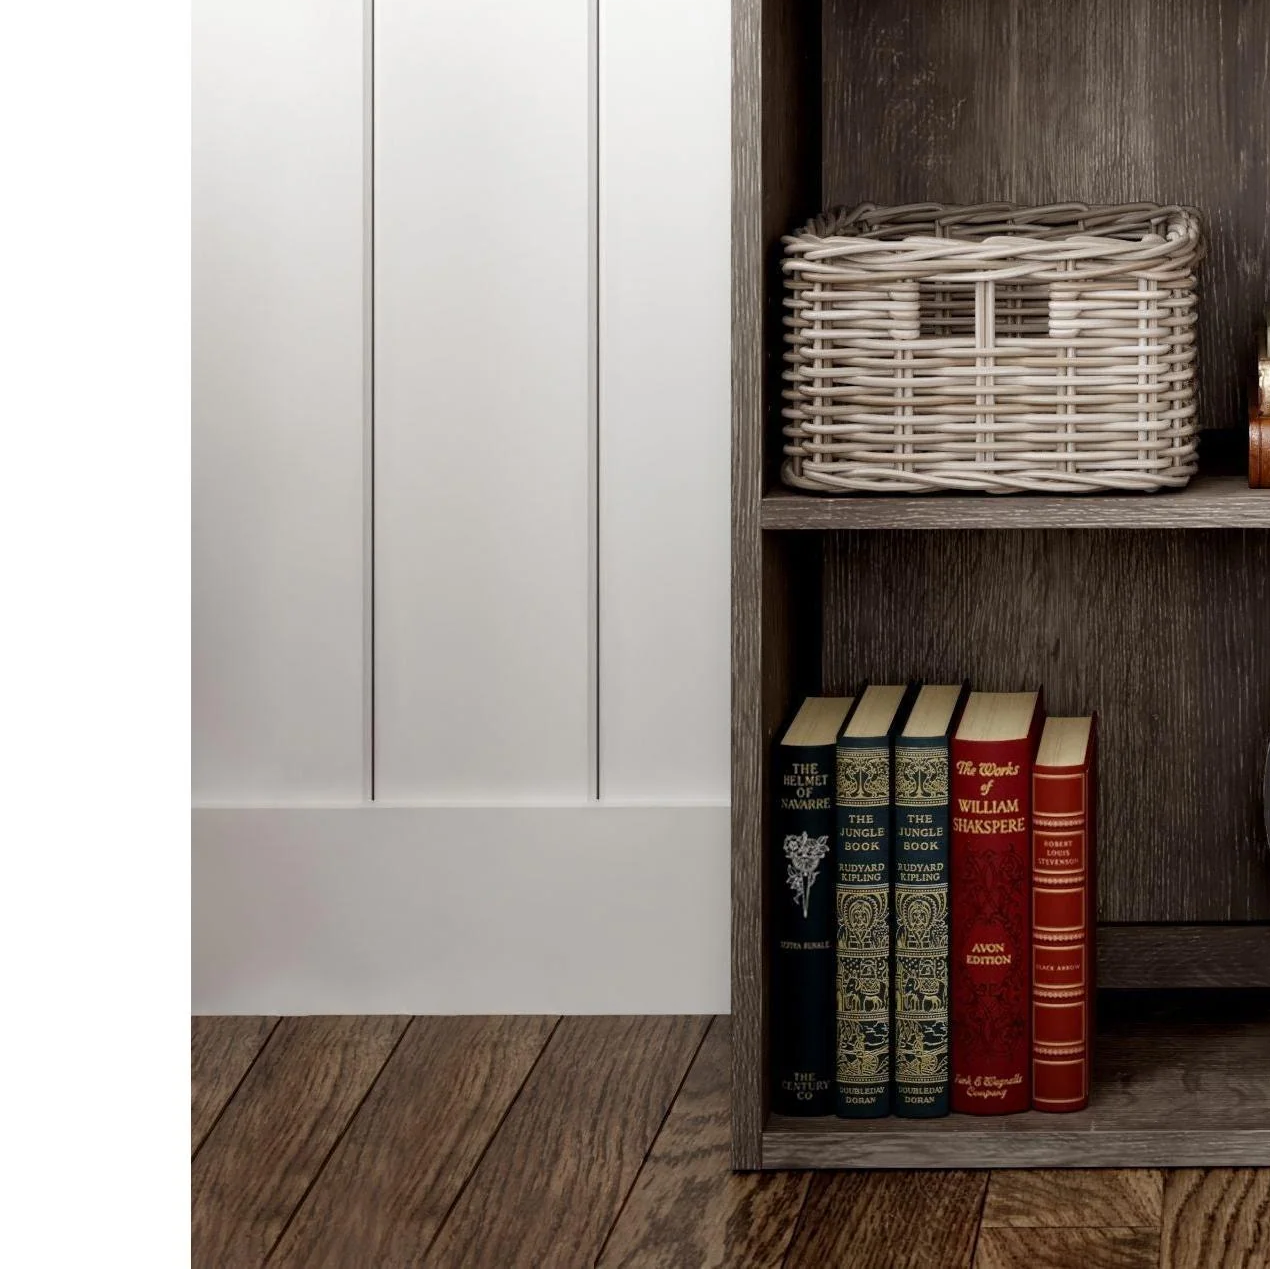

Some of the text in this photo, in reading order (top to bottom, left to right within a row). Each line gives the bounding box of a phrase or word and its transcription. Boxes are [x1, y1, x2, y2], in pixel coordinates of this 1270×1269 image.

[792, 763, 819, 774] THE
[956, 761, 1019, 777] The Works
[783, 774, 828, 786] HELMET
[796, 786, 813, 798] OF
[980, 780, 994, 795] of
[781, 798, 831, 810] NAVARRE
[959, 799, 1019, 814] WILLIAM
[848, 814, 873, 824] THE
[907, 814, 932, 824] THE
[840, 827, 884, 838] JUNGLE
[898, 827, 943, 838] JUNGLE
[844, 841, 880, 851] BOOK
[903, 841, 938, 851] BOOK
[1044, 839, 1073, 847] ROBERT
[1047, 849, 1070, 858] LOUIS
[1037, 857, 1079, 866] STEVENSON
[839, 863, 885, 872] RUDYARD
[897, 863, 943, 872] RUDYARD
[841, 872, 881, 882] KIPLING
[900, 872, 940, 882] KIPLING
[972, 942, 1005, 953] AVON
[966, 953, 1011, 965] EDITION
[793, 1072, 816, 1082] THE
[781, 1079, 831, 1092] CENTURY
[839, 1086, 885, 1095] DOUBLEDAY
[898, 1086, 943, 1095] DOUBLEDAY
[845, 1096, 876, 1105] DORAN
[904, 1096, 934, 1105] DORAN
